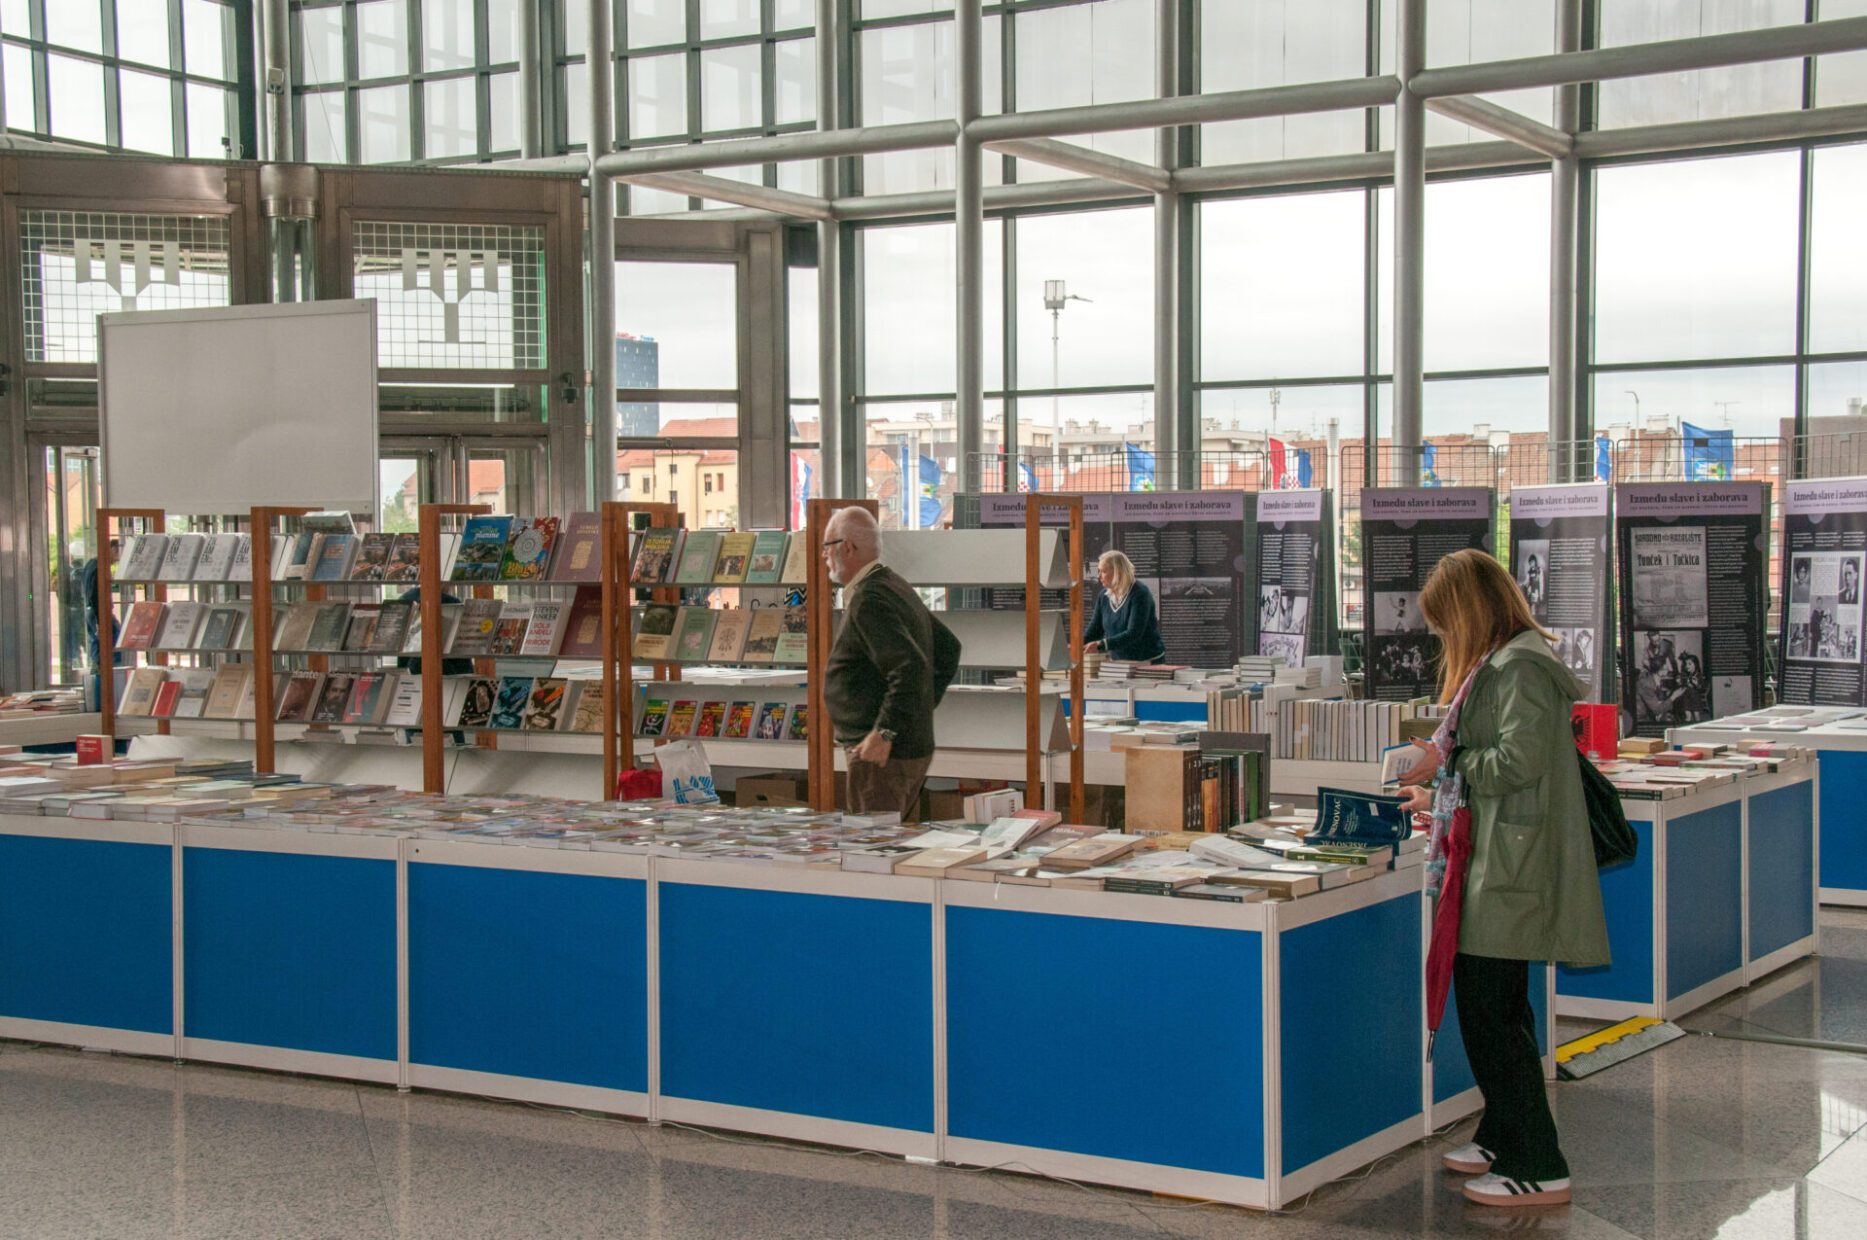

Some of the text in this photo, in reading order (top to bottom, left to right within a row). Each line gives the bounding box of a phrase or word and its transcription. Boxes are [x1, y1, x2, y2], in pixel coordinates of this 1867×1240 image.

[1407, 498, 1430, 507] slave
[1436, 497, 1477, 507] zaborava
[1669, 493, 1695, 503] slave
[1702, 492, 1748, 502] zaborava
[1160, 501, 1183, 510] slave
[1190, 500, 1231, 510] zaborava
